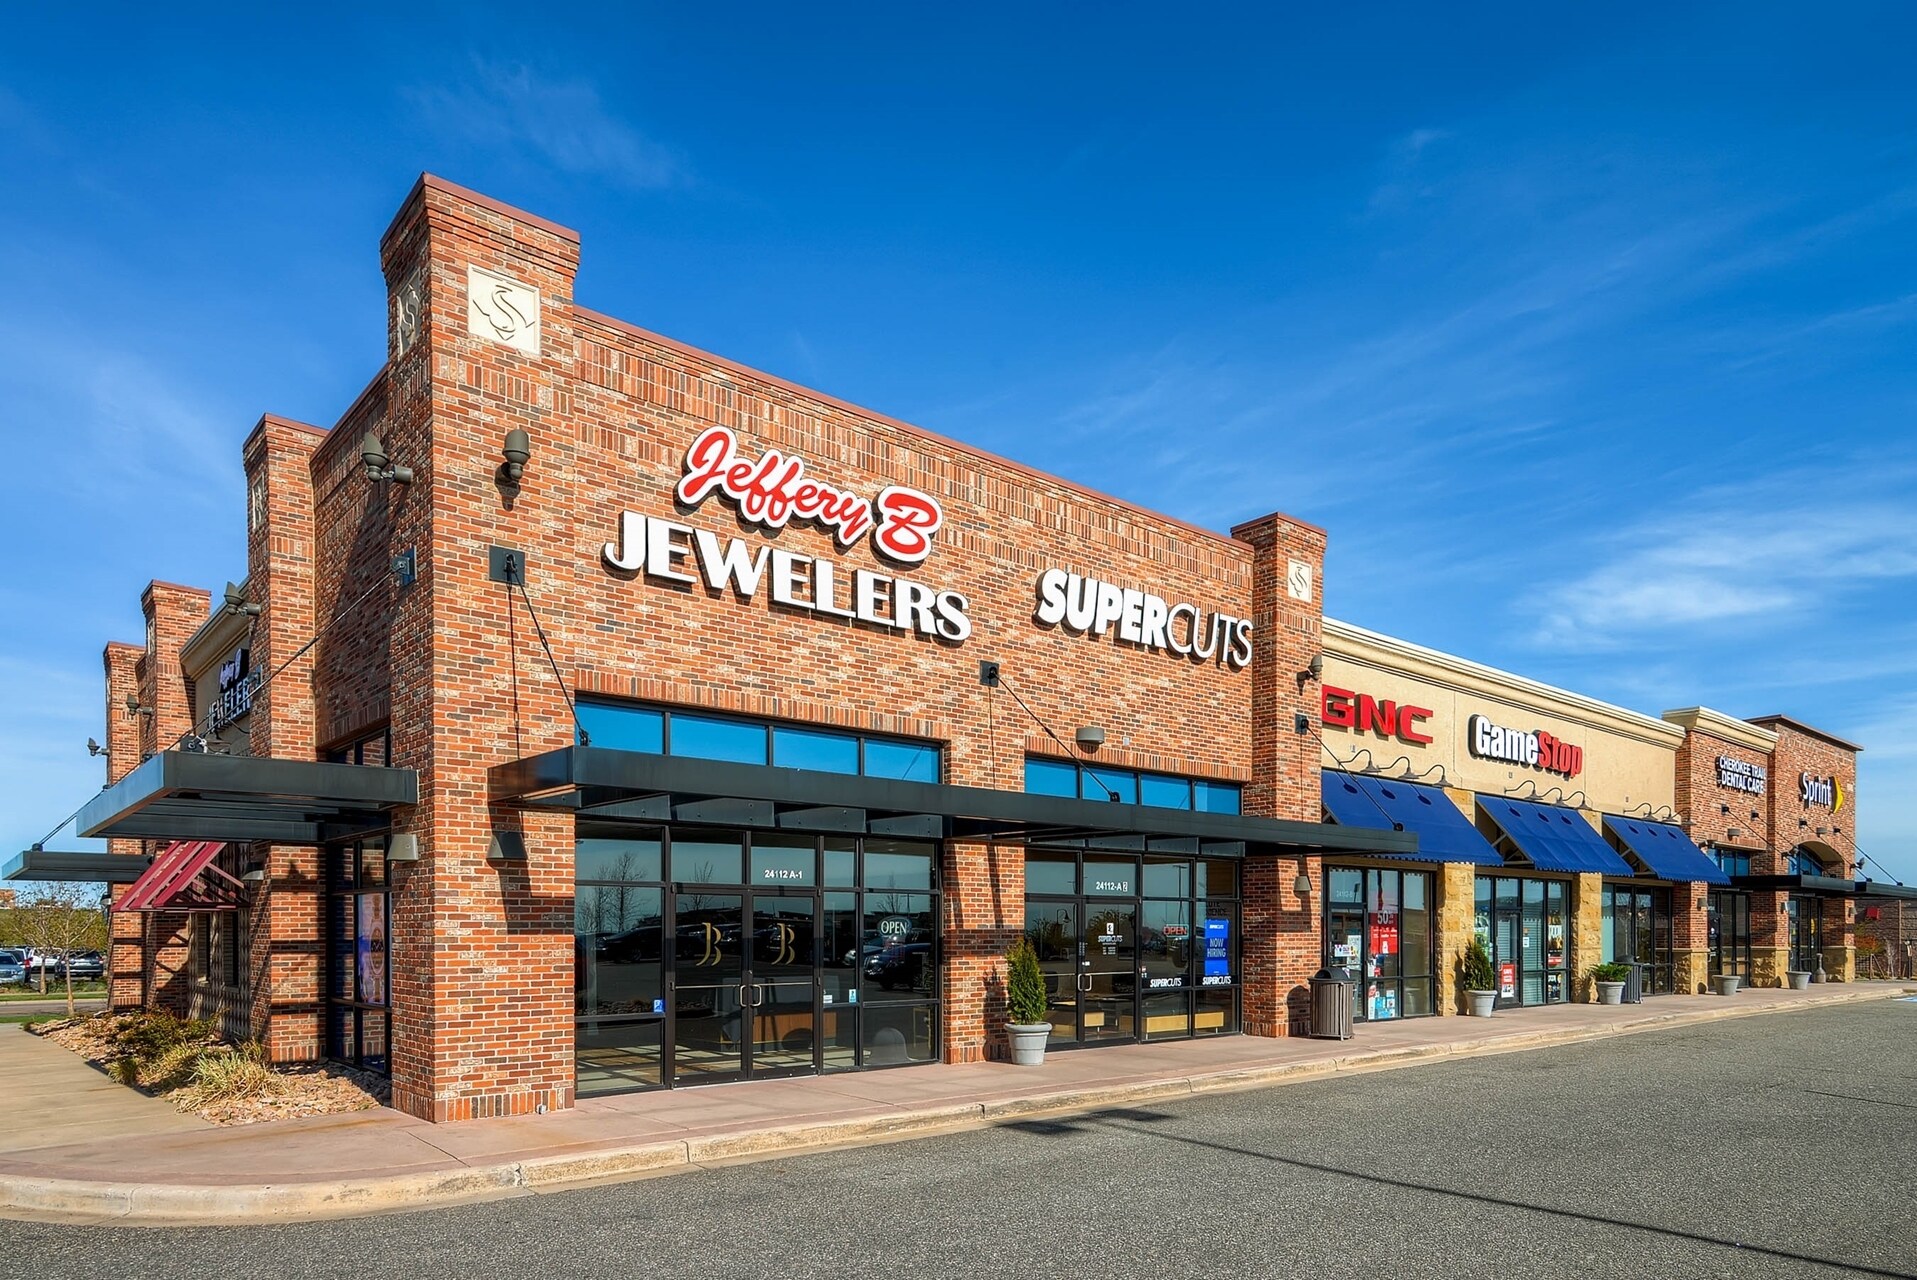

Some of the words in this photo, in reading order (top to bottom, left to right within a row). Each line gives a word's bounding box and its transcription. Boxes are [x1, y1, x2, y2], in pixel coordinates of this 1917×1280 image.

[679, 426, 872, 544] Jeffery
[877, 487, 942, 561] B
[604, 511, 972, 641] JEWELERS
[1036, 568, 1253, 667] SUPERCUTS
[1321, 684, 1433, 743] GNC
[1475, 715, 1583, 778] GameStop
[1719, 756, 1751, 775] CHEROKEE
[1721, 770, 1747, 790] DENTAL
[1747, 777, 1765, 794] CARE
[1802, 772, 1832, 808] Sprint
[764, 870, 788, 879] 24112
[789, 871, 803, 879] A-1
[1377, 910, 1389, 925] 50
[880, 920, 908, 935] OPEN
[1163, 926, 1188, 936] OPEN
[1097, 935, 1123, 943] SUPERCUTS
[1209, 938, 1224, 948] NOW
[1206, 948, 1227, 958] HIRING
[1149, 978, 1182, 988] SUPERCUTS
[1202, 976, 1232, 986] SUPERCUTS
